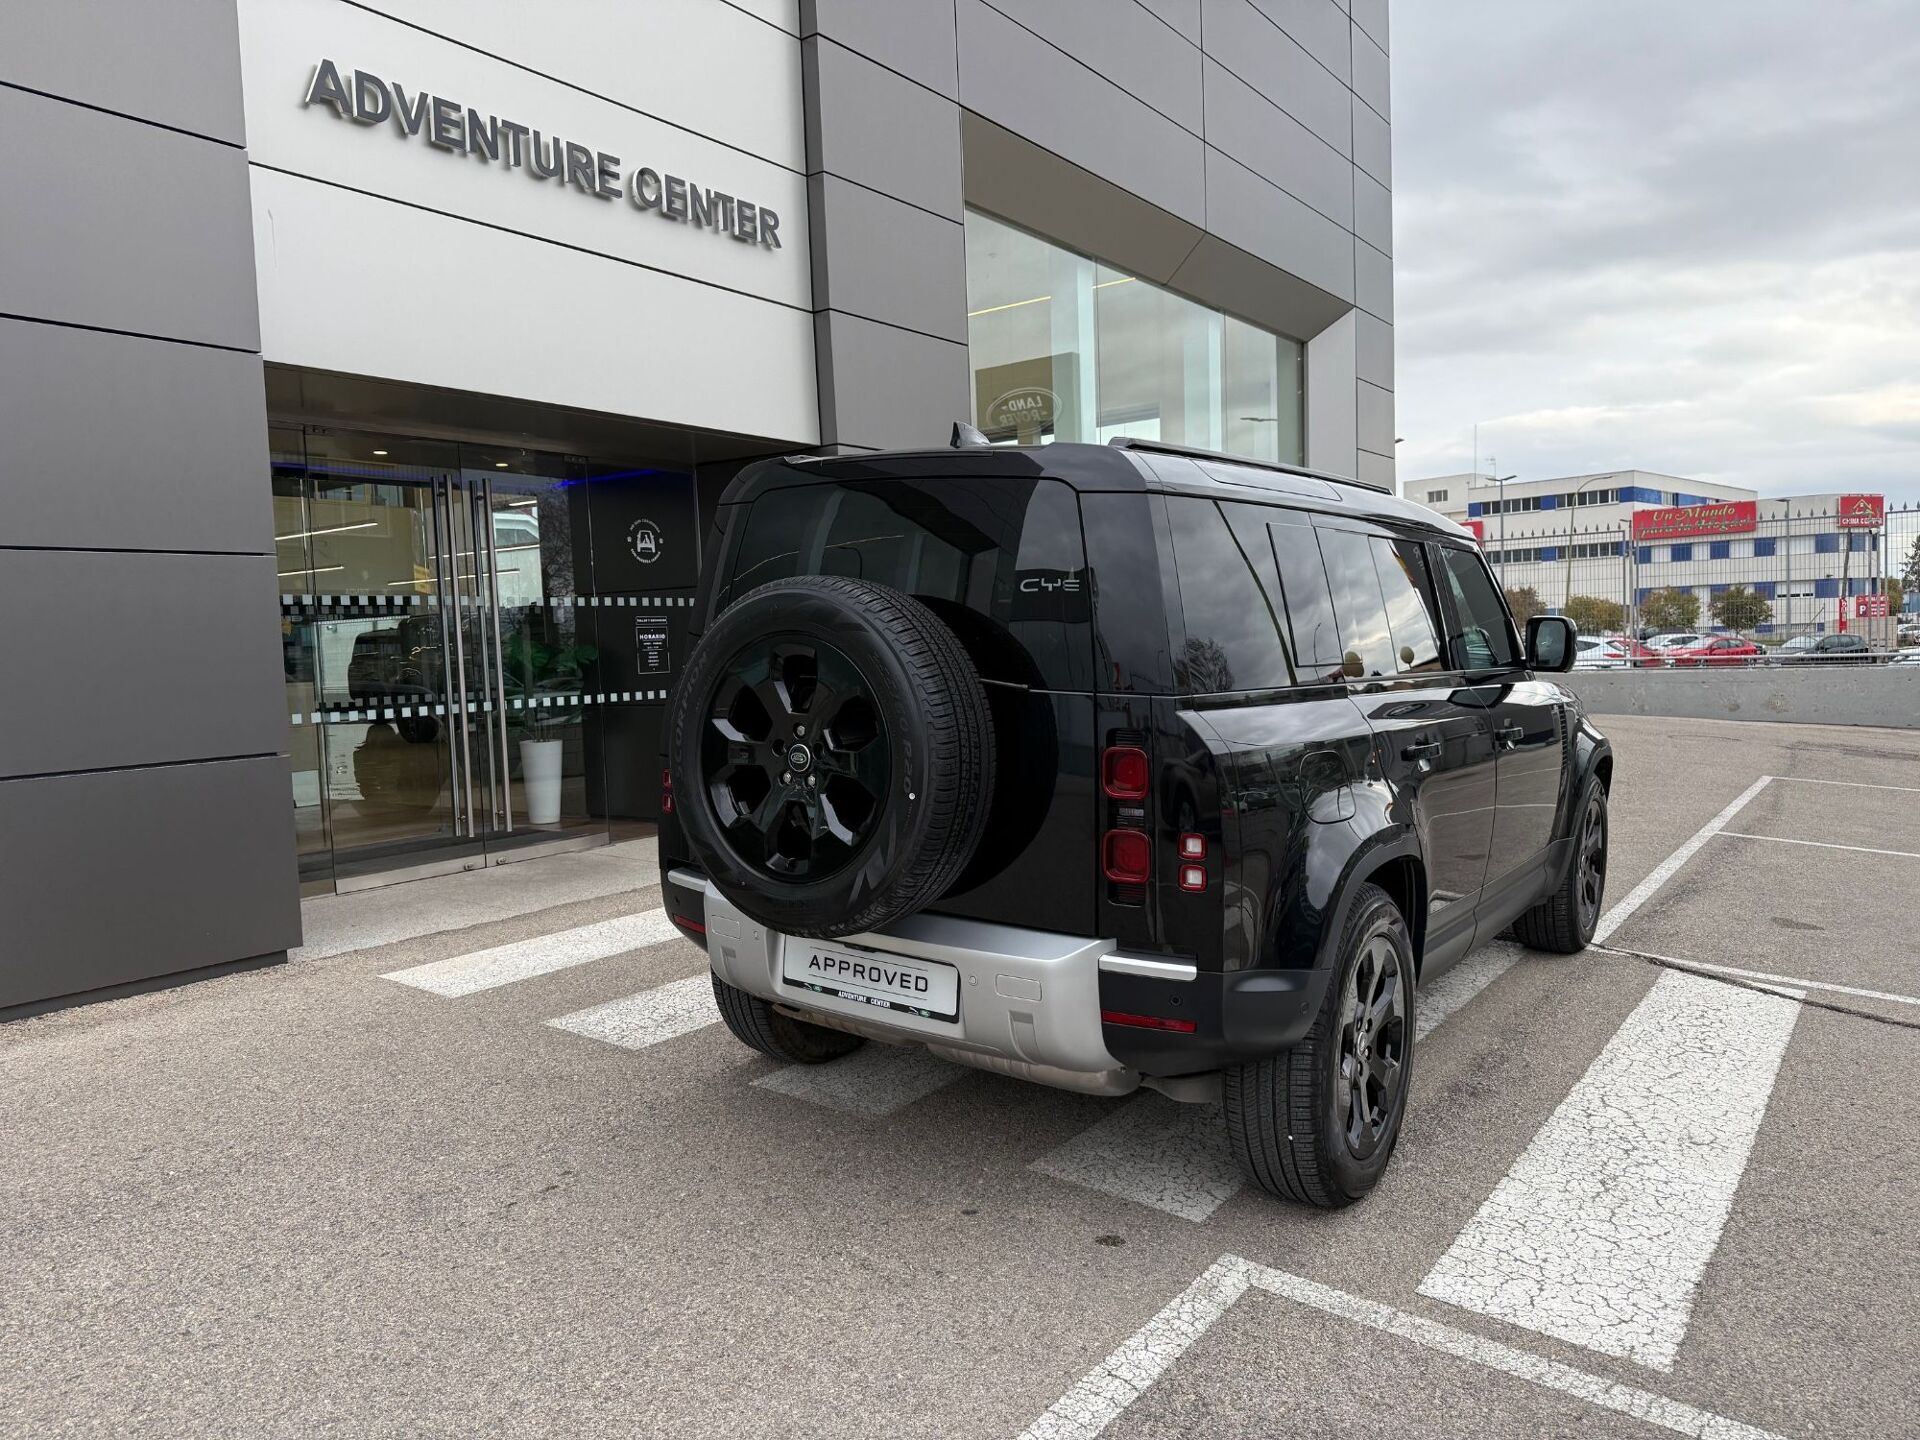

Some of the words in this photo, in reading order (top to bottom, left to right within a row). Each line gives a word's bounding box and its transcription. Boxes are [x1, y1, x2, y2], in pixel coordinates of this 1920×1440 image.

[305, 58, 623, 201] ADVENTURE
[631, 167, 782, 249] CENTER
[1653, 511, 1673, 521] Un
[1675, 505, 1735, 520] Mundo
[1859, 605, 1867, 615] P
[808, 955, 928, 992] APPROVED
[837, 990, 867, 1003] ADVENTURE
[870, 998, 891, 1009] CENTER
